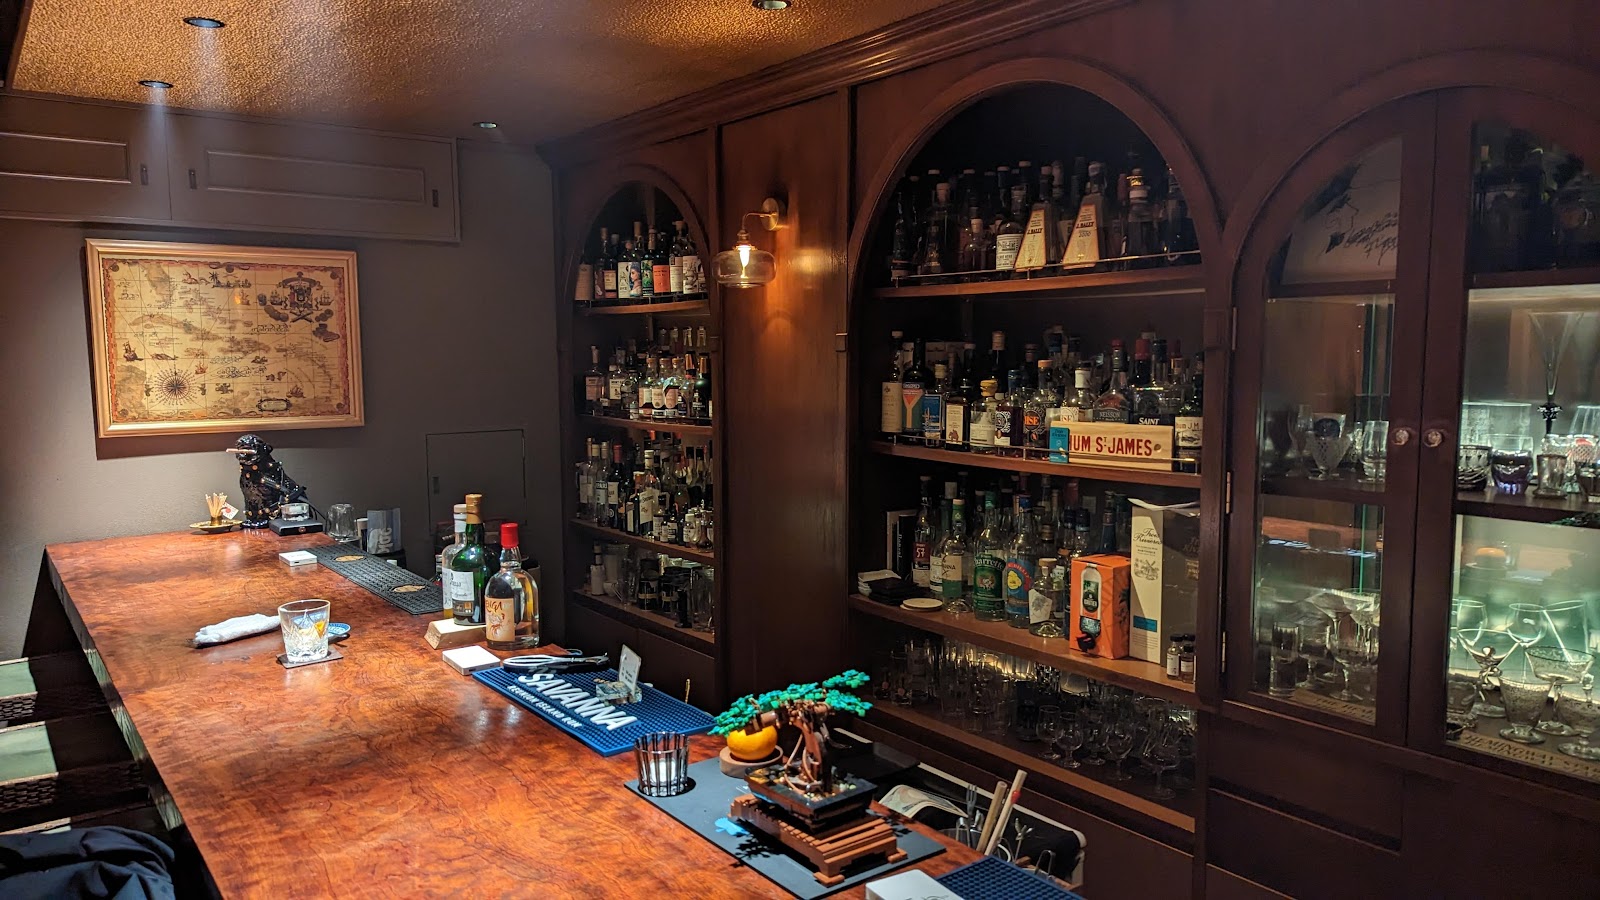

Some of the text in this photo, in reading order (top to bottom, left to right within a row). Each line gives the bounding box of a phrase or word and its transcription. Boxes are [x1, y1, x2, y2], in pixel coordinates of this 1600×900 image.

[1139, 417, 1160, 425] SAINT
[1108, 437, 1153, 457] JAMES
[518, 673, 637, 731] SAVANNA
[535, 701, 565, 718] ISLAND
